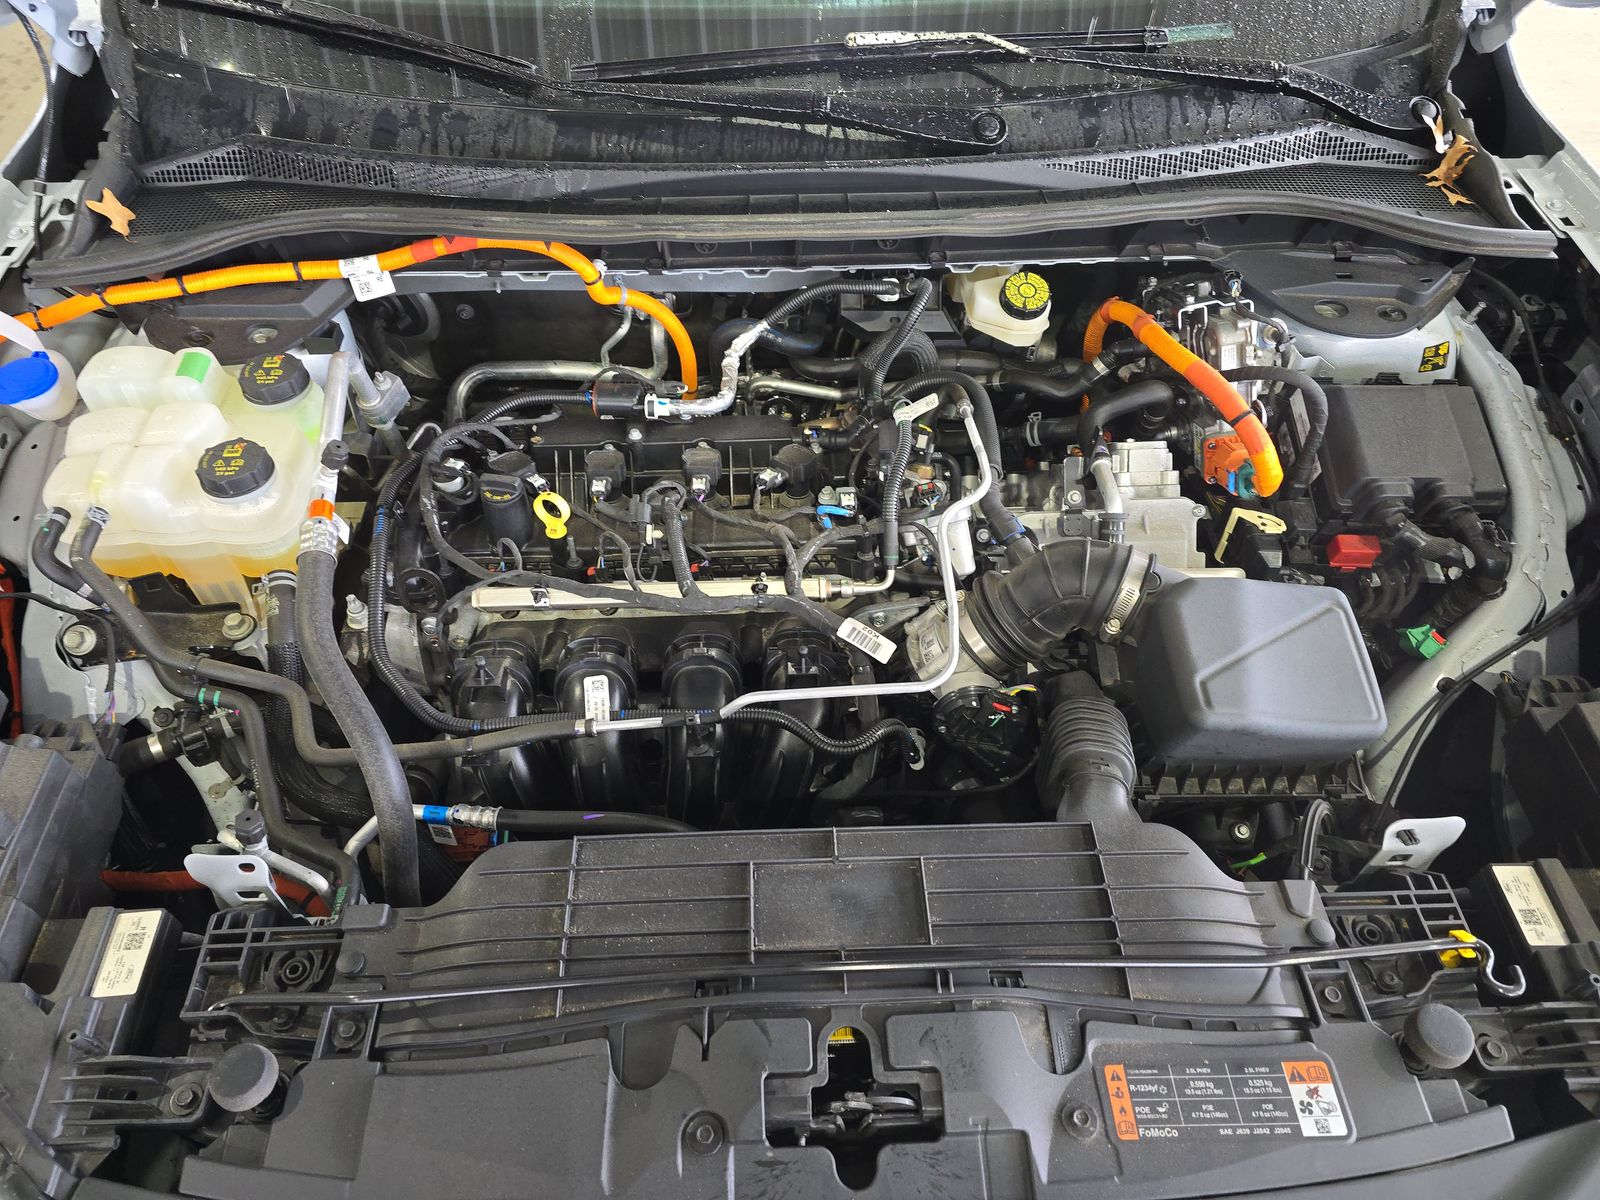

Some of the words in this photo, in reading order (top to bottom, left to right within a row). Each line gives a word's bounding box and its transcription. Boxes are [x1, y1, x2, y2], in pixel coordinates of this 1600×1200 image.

[861, 626, 880, 639] K02
[1205, 1080, 1214, 1089] kg
[1264, 1079, 1273, 1088] kg
[1129, 1084, 1159, 1093] R-1234yf
[1135, 1106, 1151, 1114] POE
[1138, 1128, 1179, 1138] FoMoCo
